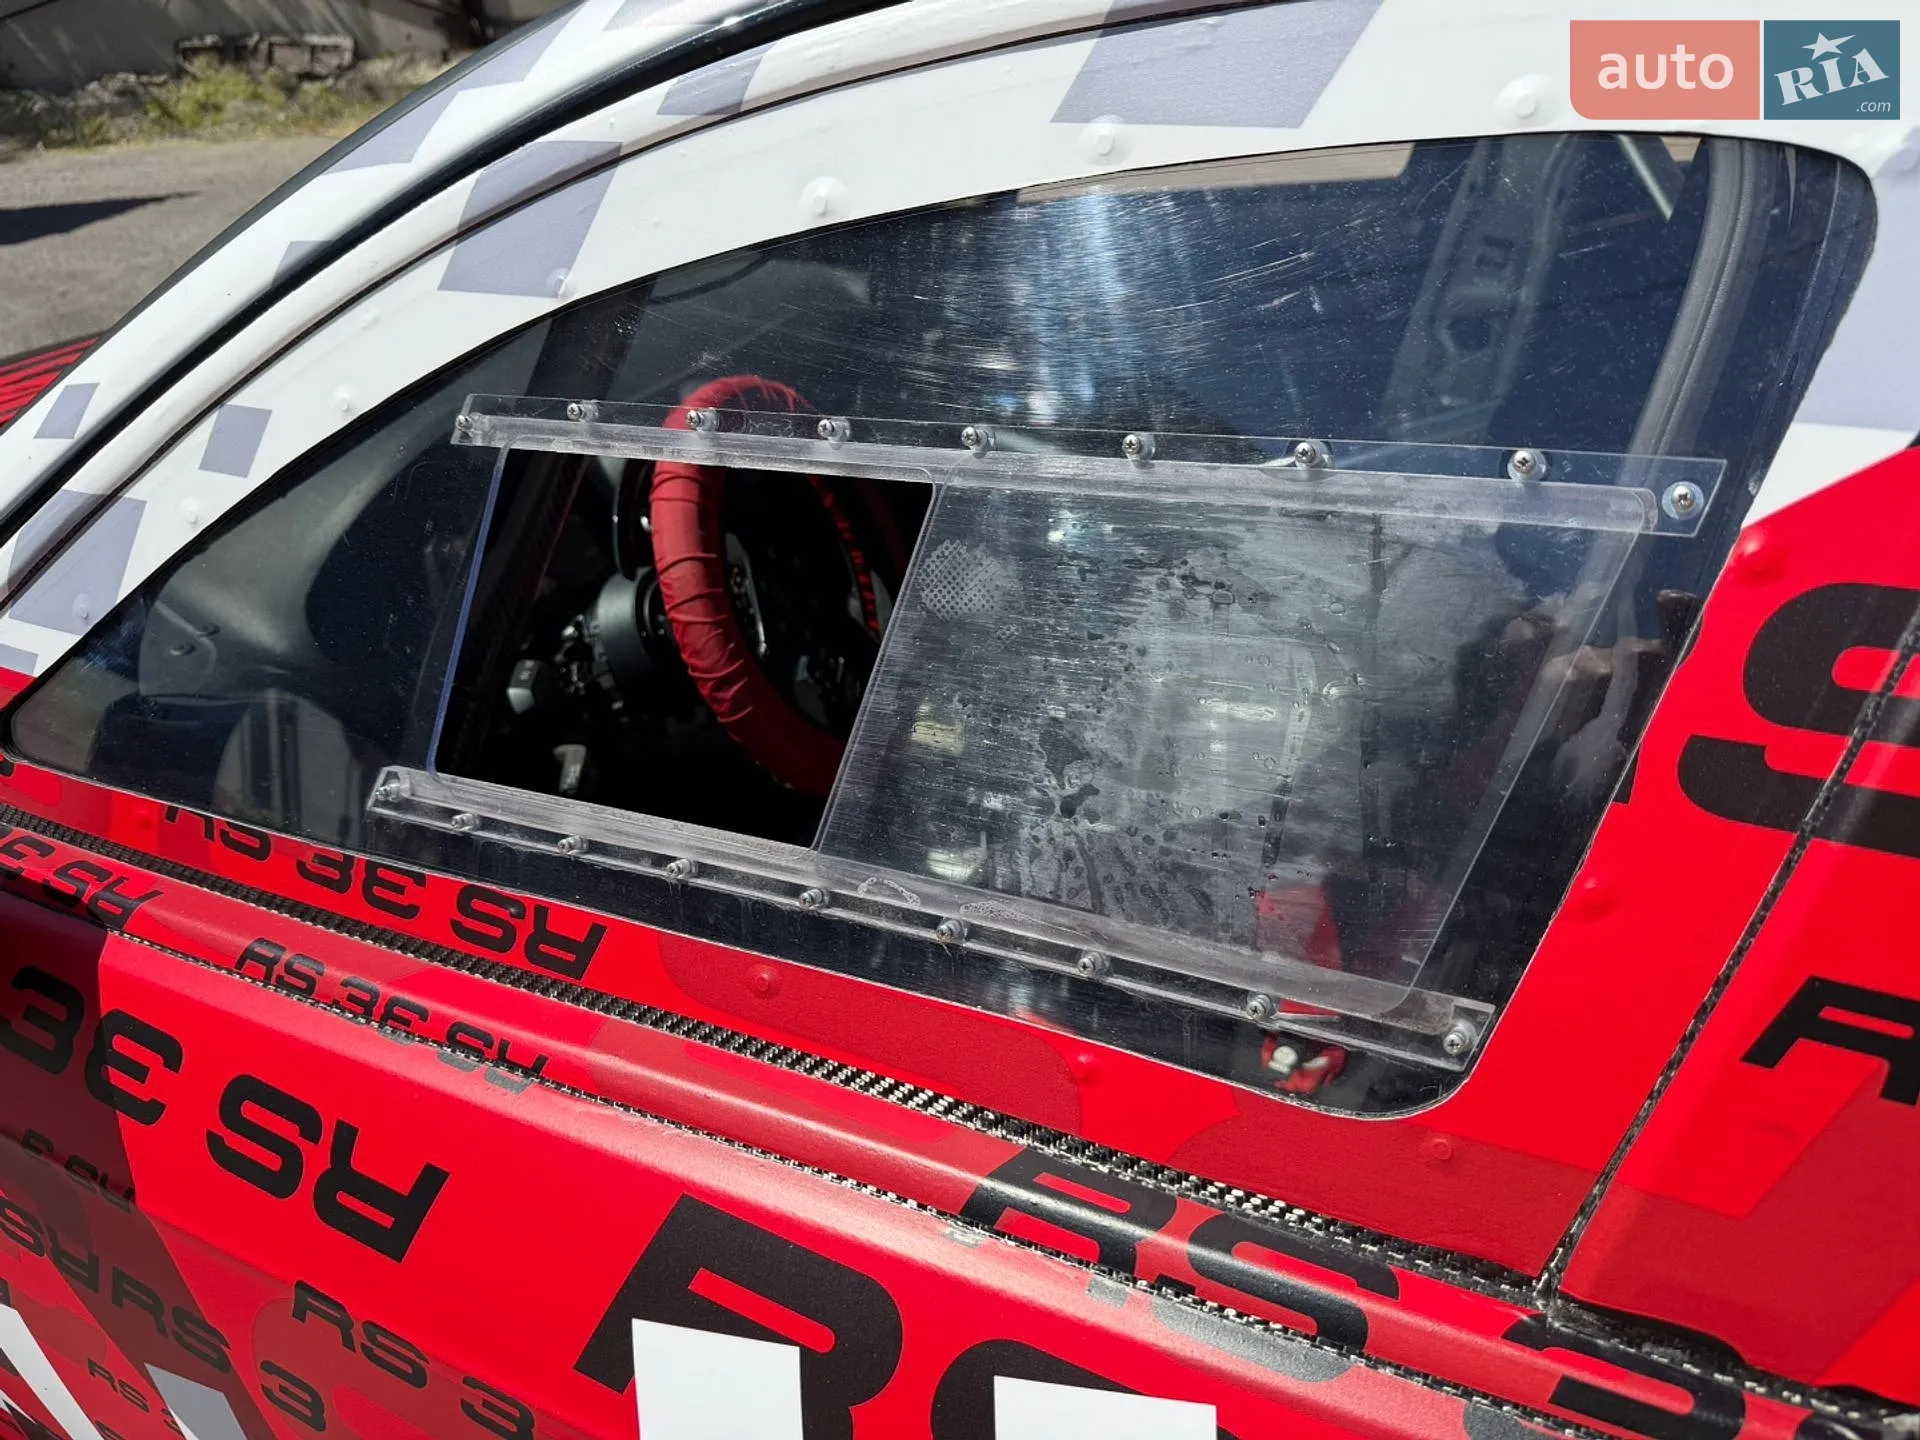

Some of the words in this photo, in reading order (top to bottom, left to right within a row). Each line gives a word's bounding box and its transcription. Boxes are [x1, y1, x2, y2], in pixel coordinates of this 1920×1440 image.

[235, 937, 325, 999] RS
[451, 884, 607, 981] RS
[205, 1074, 451, 1263] RS
[111, 1266, 232, 1374] RS
[292, 1279, 431, 1389] RS
